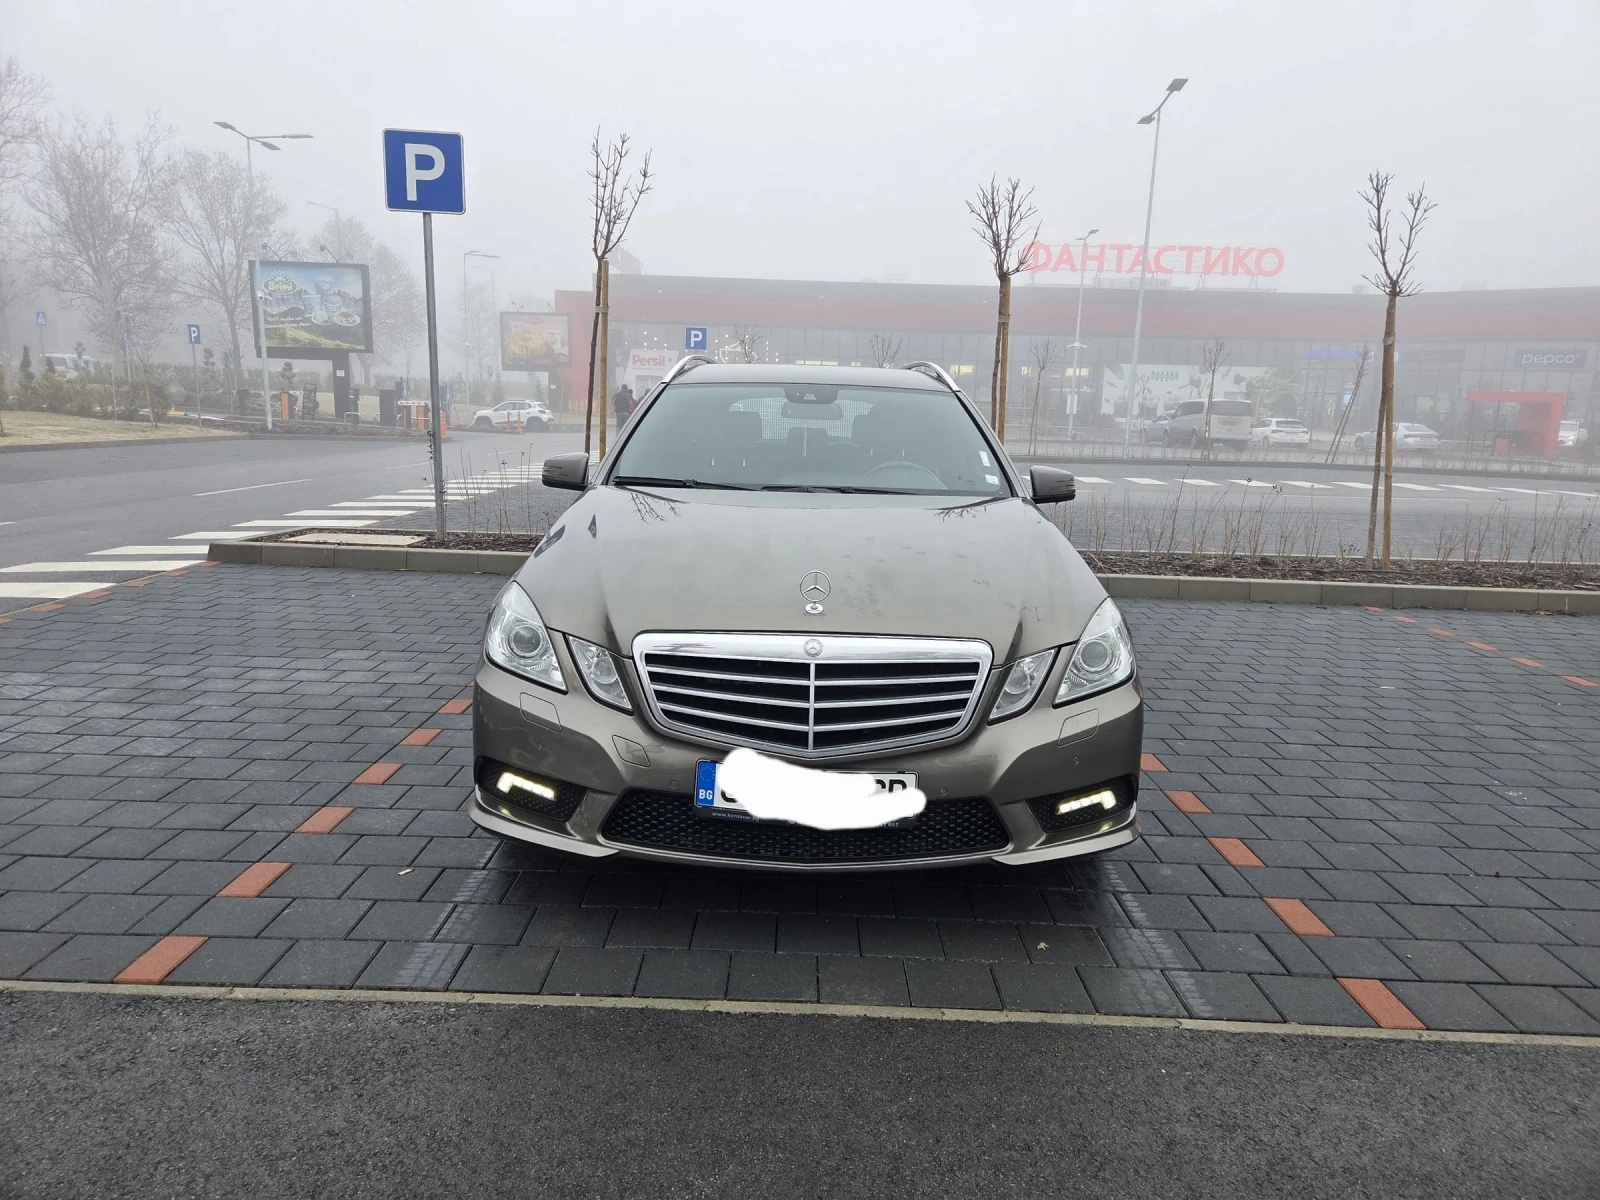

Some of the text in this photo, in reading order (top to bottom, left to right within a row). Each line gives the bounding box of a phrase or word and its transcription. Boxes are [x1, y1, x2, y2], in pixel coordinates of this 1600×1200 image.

[404, 143, 445, 201] P
[1024, 240, 1285, 277] ФАНТАСТИКО
[268, 281, 293, 291] Brimi
[190, 326, 198, 343] P
[690, 330, 703, 348] P
[632, 354, 665, 367] Persil
[1522, 353, 1575, 366] pepco
[698, 788, 713, 800] BG
